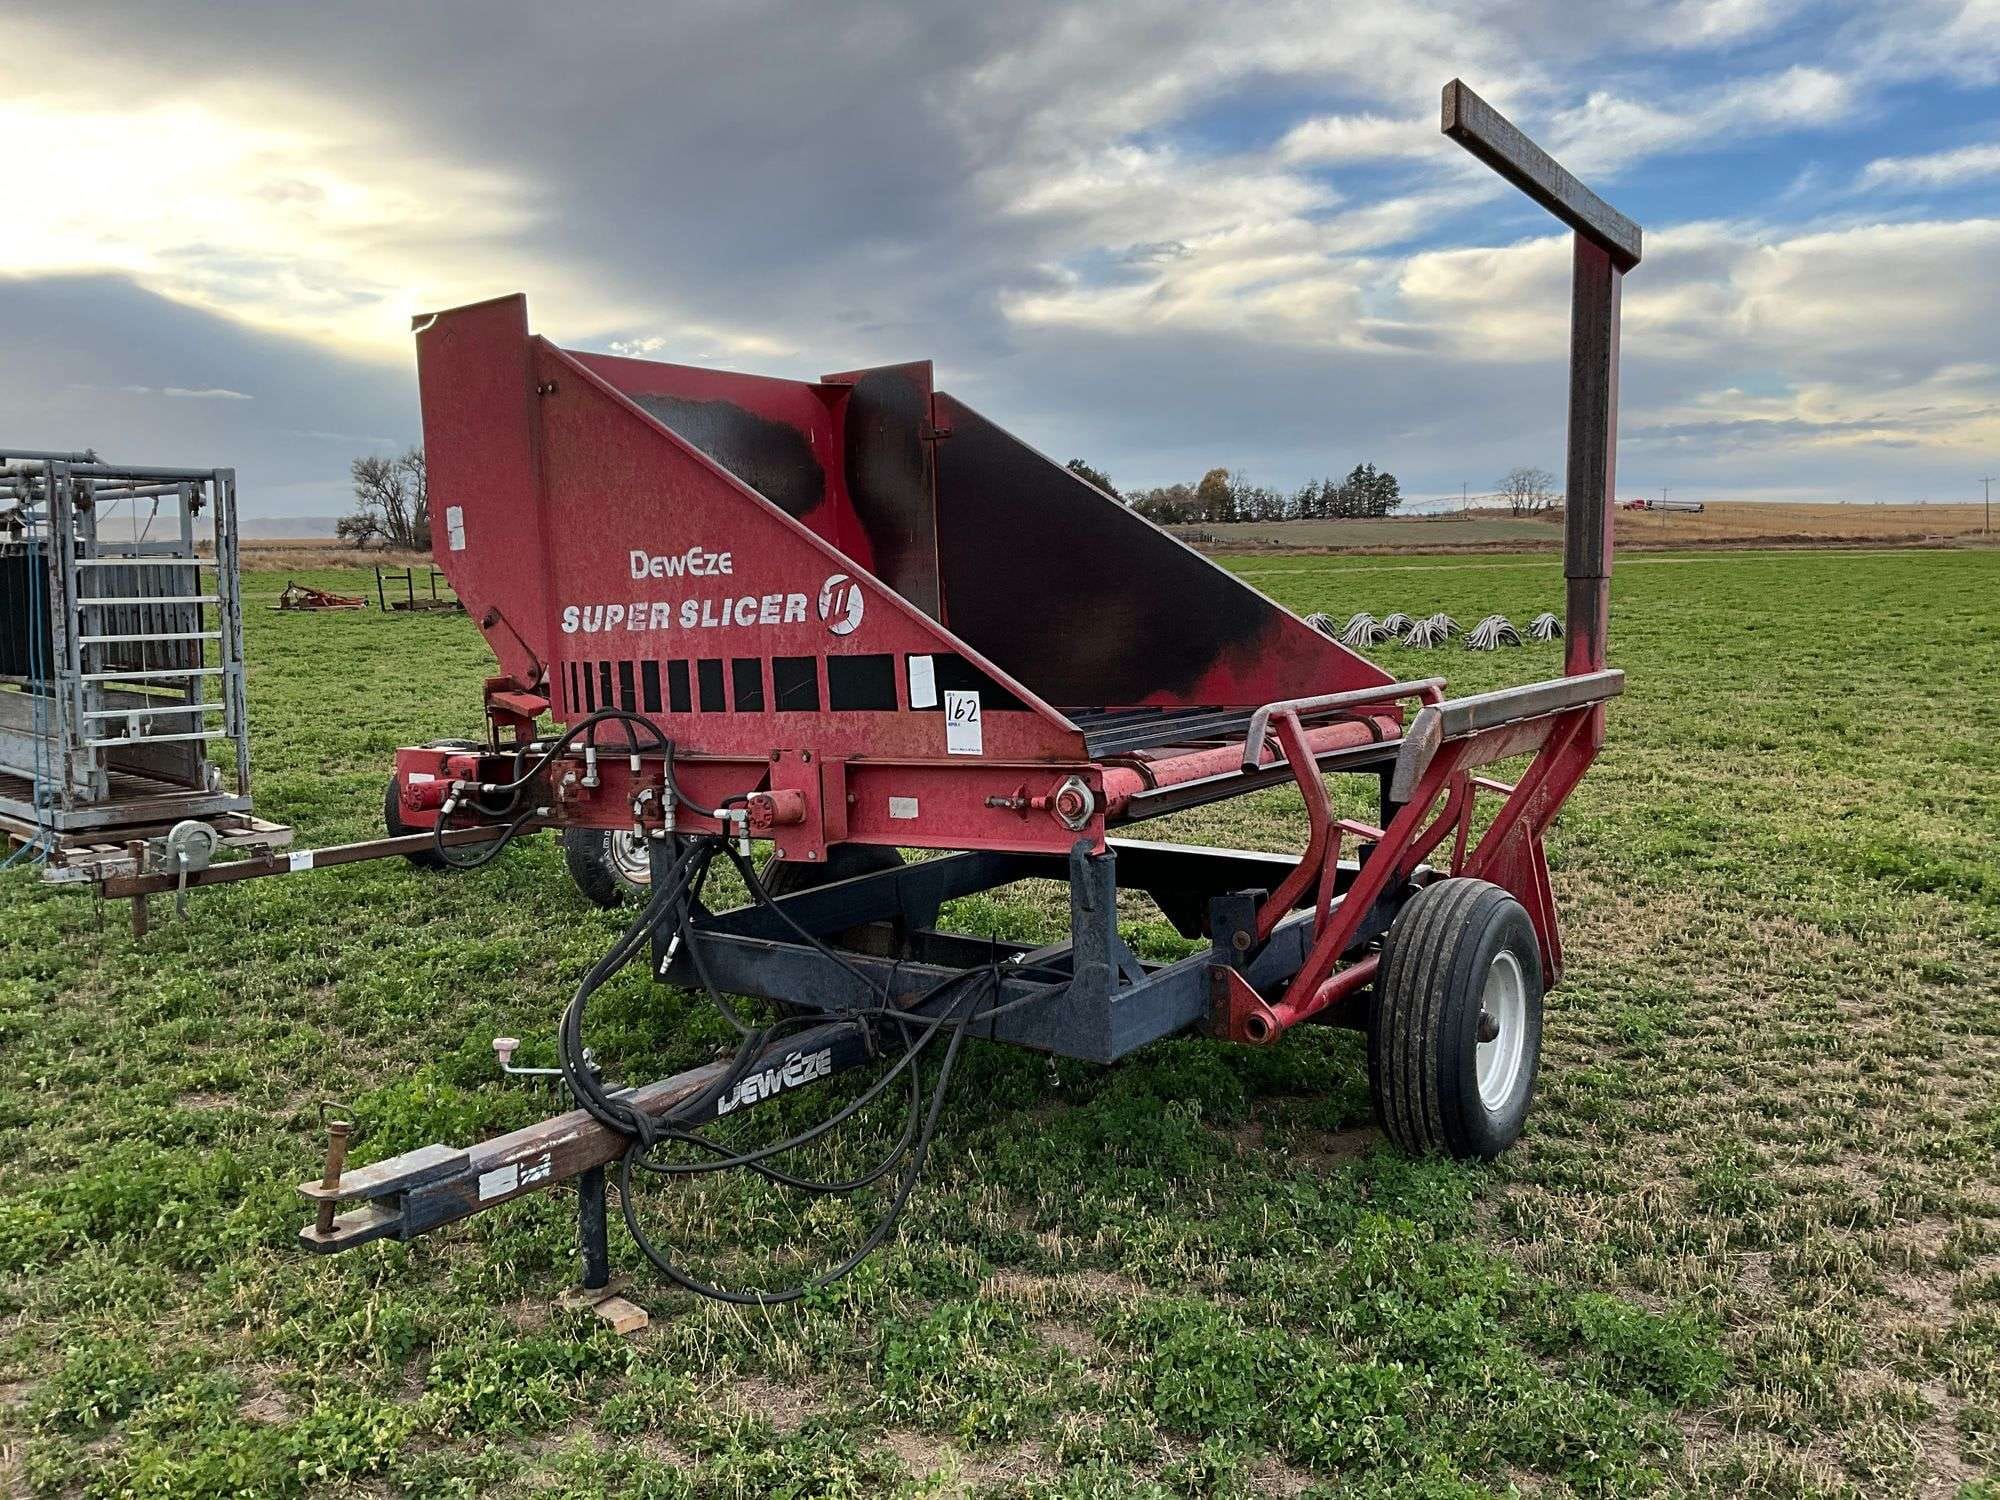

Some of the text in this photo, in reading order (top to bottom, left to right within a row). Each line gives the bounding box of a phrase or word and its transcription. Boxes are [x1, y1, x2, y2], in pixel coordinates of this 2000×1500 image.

[561, 602, 671, 634] SUPER
[679, 593, 808, 629] SLICER
[948, 696, 978, 722] 162
